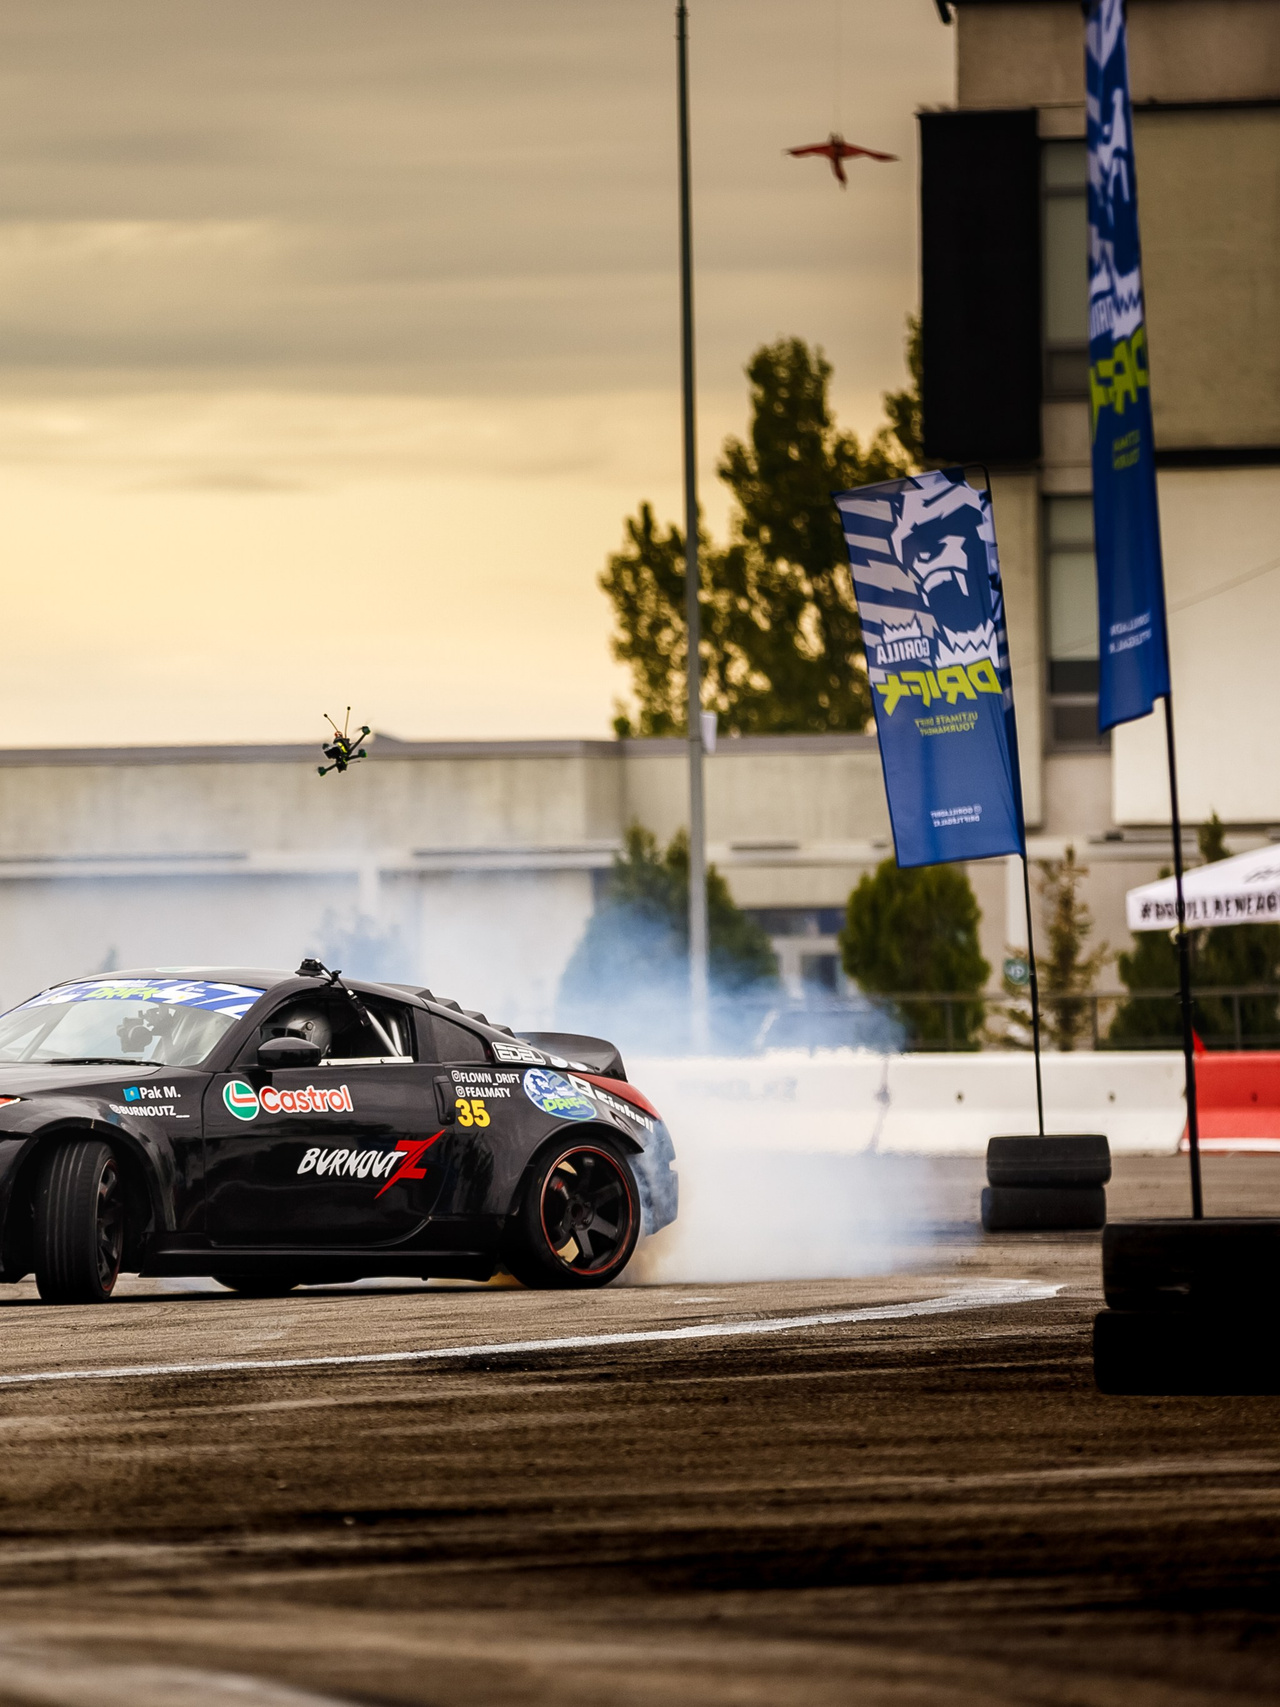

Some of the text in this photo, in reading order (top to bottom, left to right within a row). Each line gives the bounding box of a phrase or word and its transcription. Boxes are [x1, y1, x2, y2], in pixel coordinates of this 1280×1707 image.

[139, 1086, 182, 1099] Pak M.
[259, 1085, 353, 1113] Castrol
[455, 1098, 491, 1128] 35
